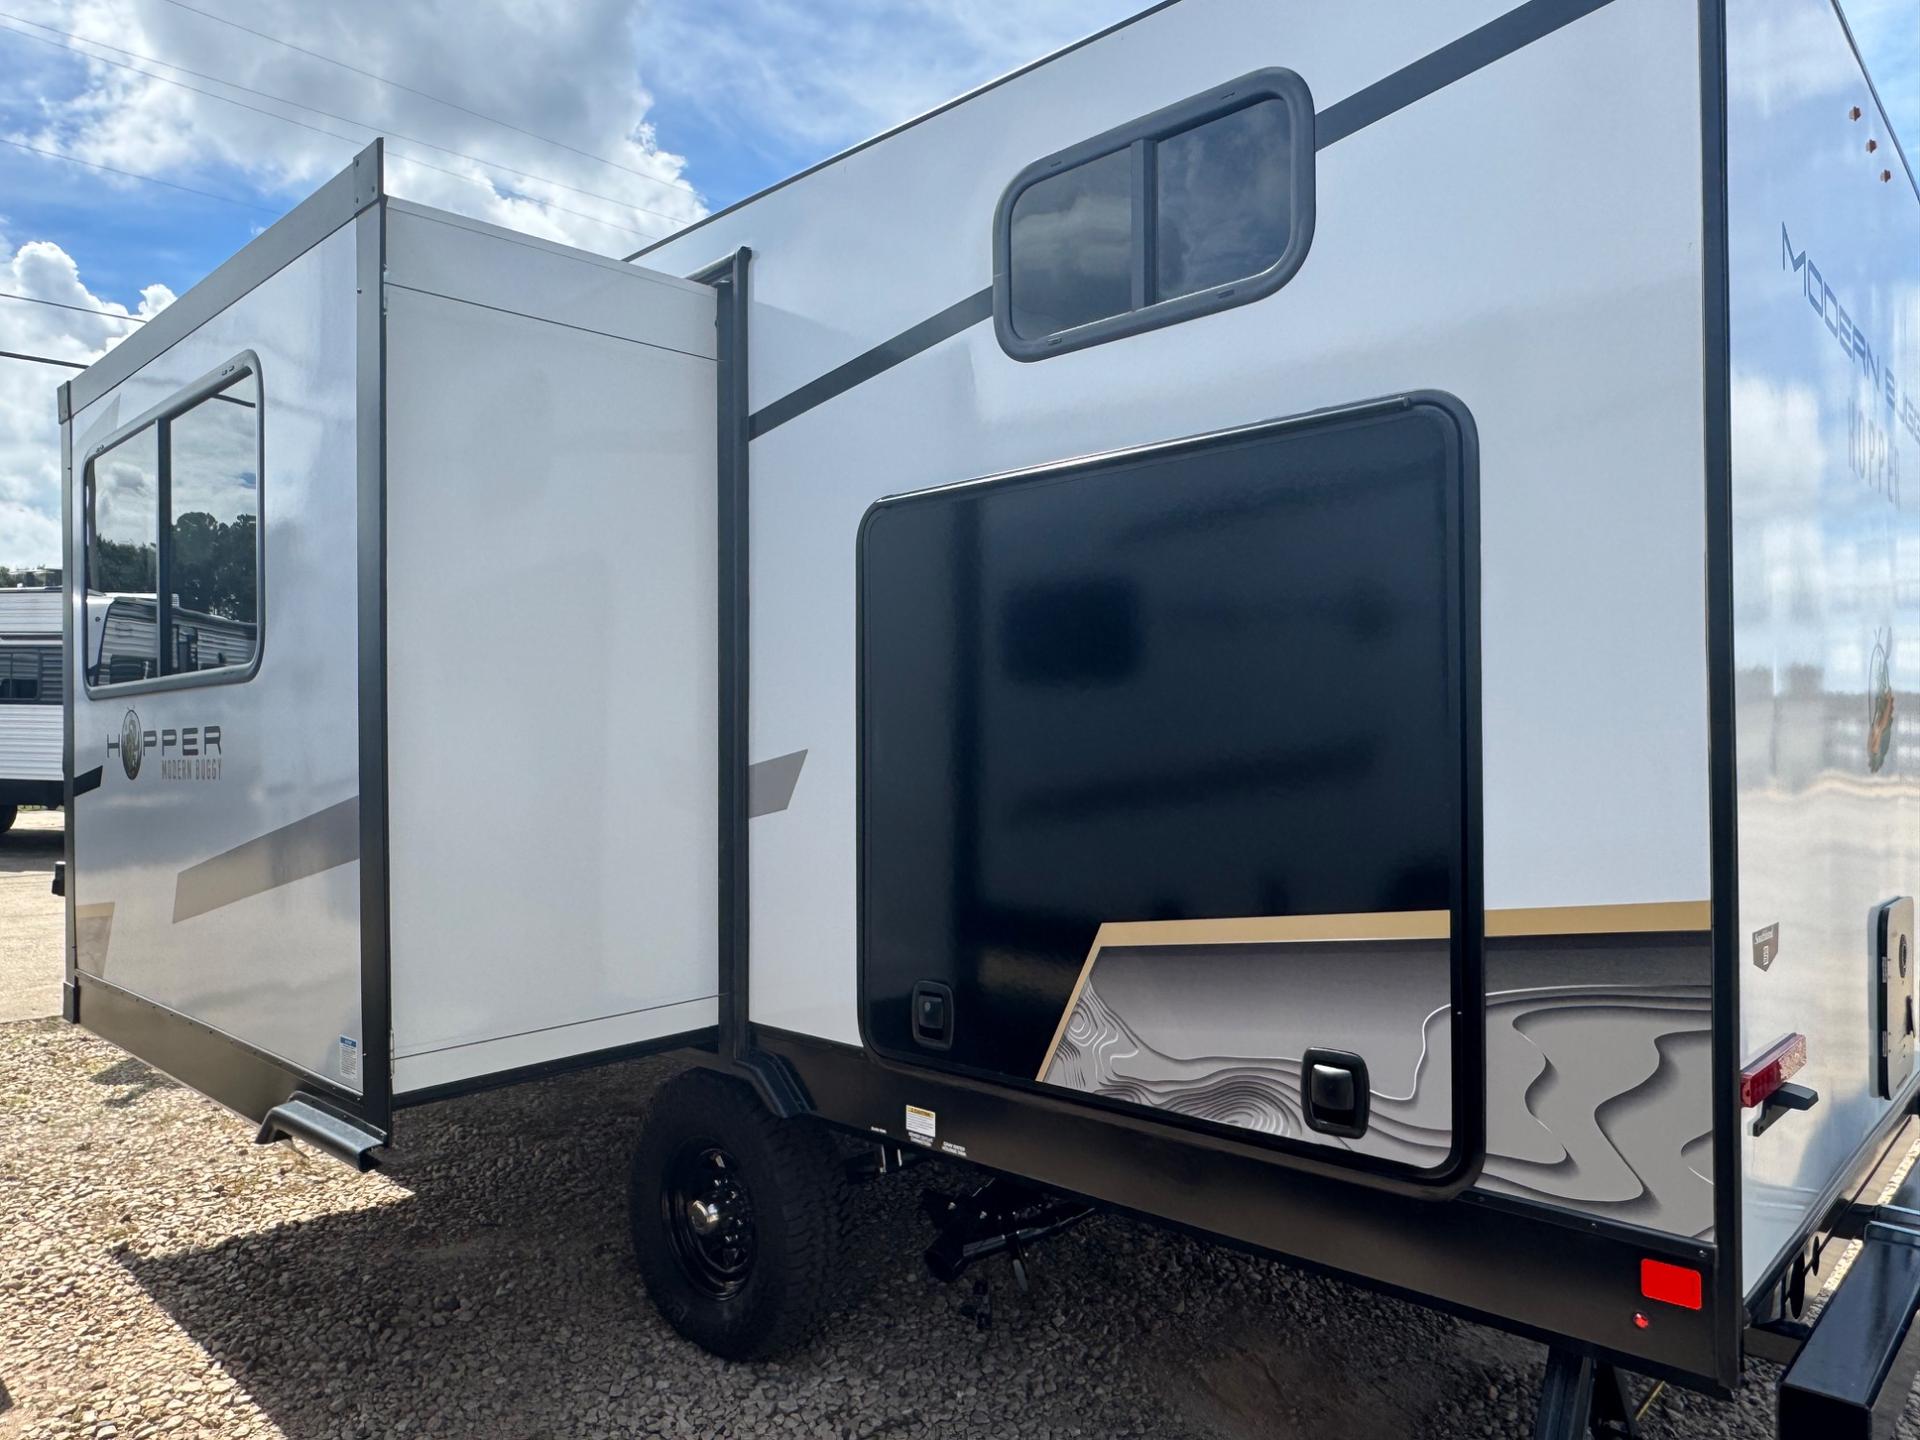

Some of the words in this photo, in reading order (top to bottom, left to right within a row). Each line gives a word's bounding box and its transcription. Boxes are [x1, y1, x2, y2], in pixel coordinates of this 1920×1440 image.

[1781, 221, 1879, 392] MODERN
[107, 709, 221, 780] HOPPER
[161, 759, 192, 780] MODERN
[195, 759, 222, 780] BUGGY
